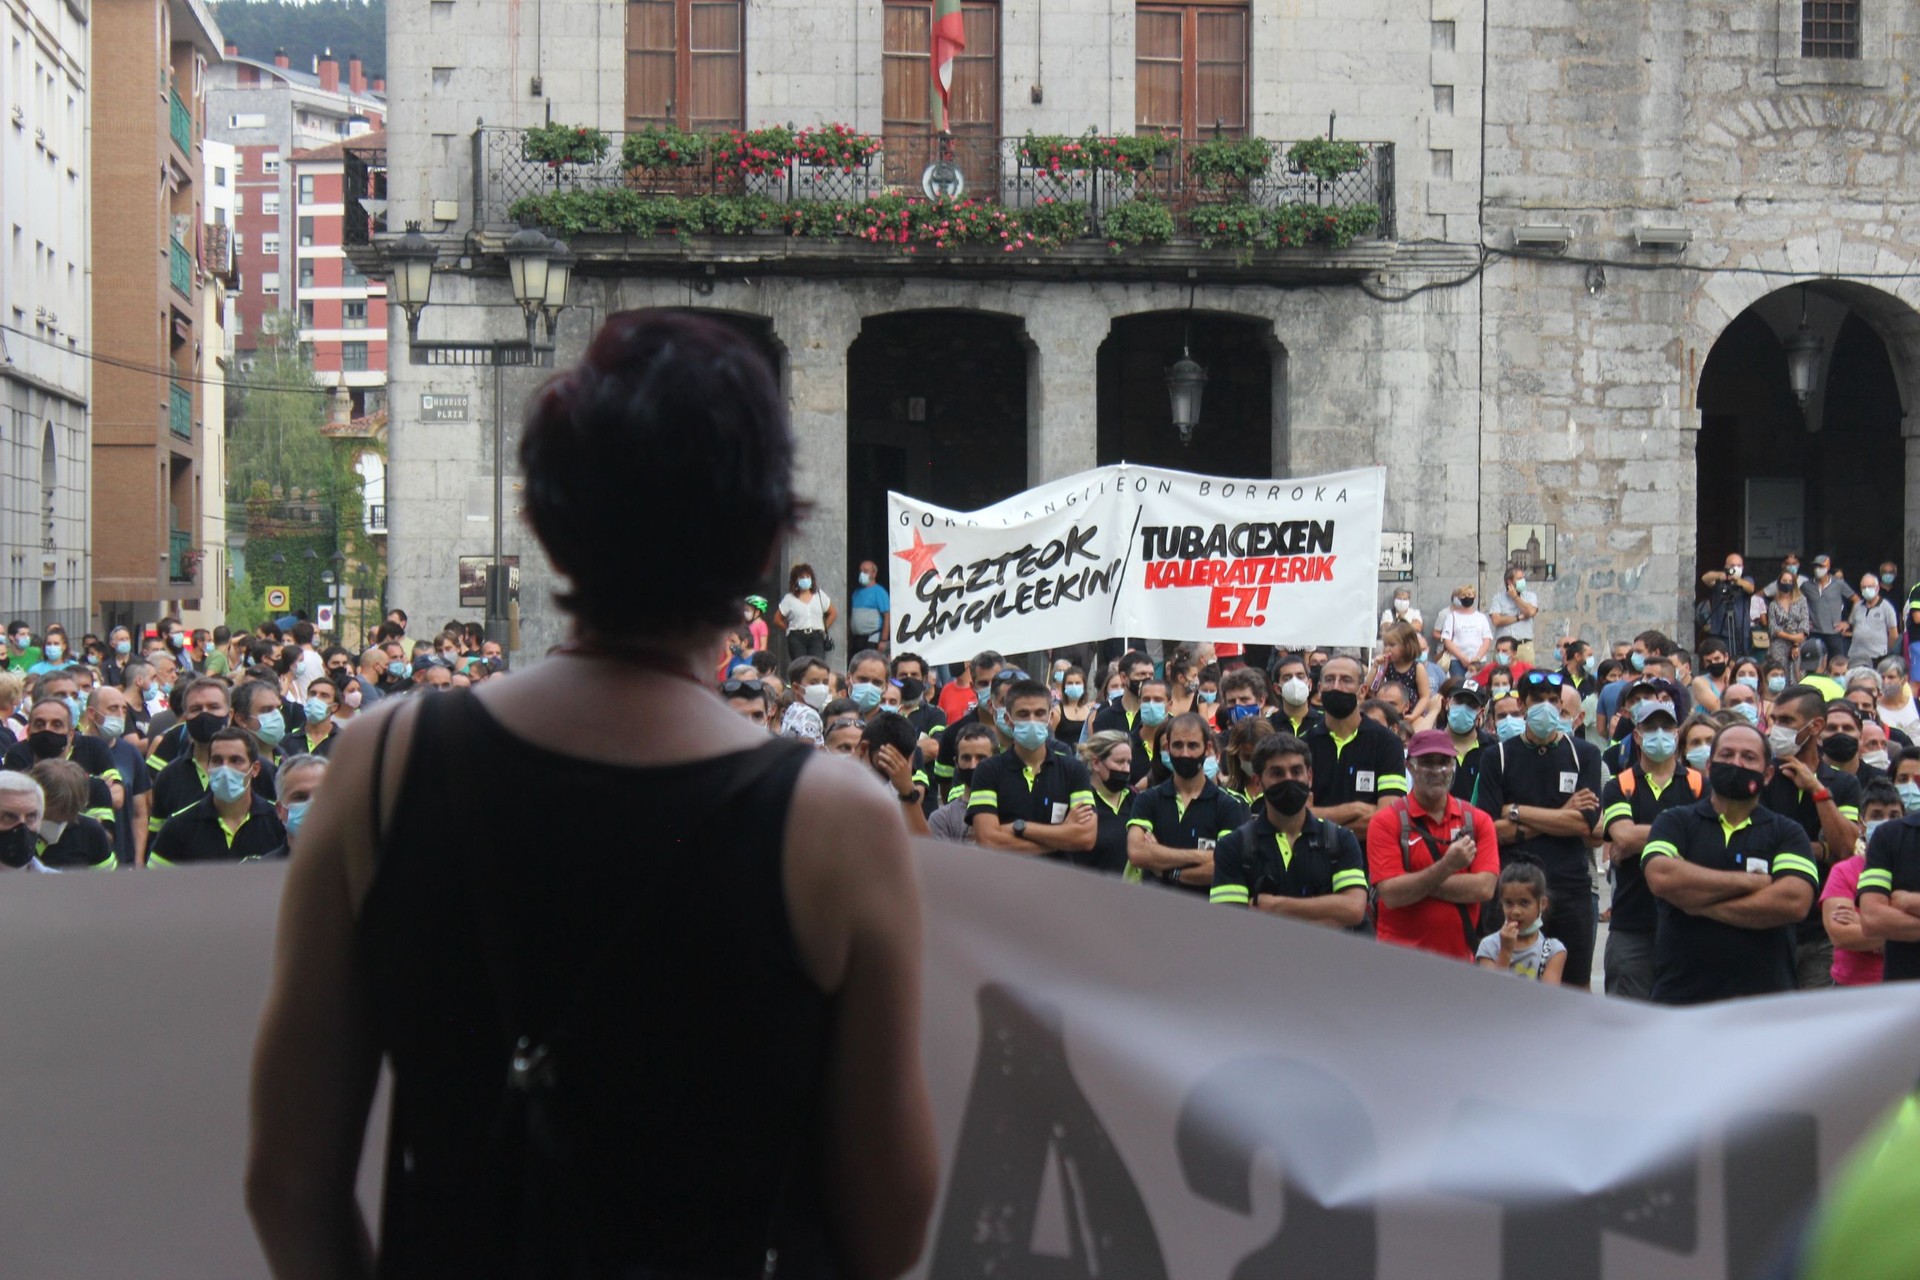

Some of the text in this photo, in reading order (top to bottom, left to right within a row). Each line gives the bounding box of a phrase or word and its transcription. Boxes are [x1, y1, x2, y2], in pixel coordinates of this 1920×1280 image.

[433, 397, 467, 407] HERRIKO
[437, 410, 463, 419] PLAZA
[1199, 481, 1348, 503] BORROKA
[1140, 519, 1335, 561] TUBACEXEN
[915, 525, 1101, 605] GAZTEOK
[1144, 554, 1338, 590] KALERATZERIK
[1207, 584, 1272, 629] EZ!
